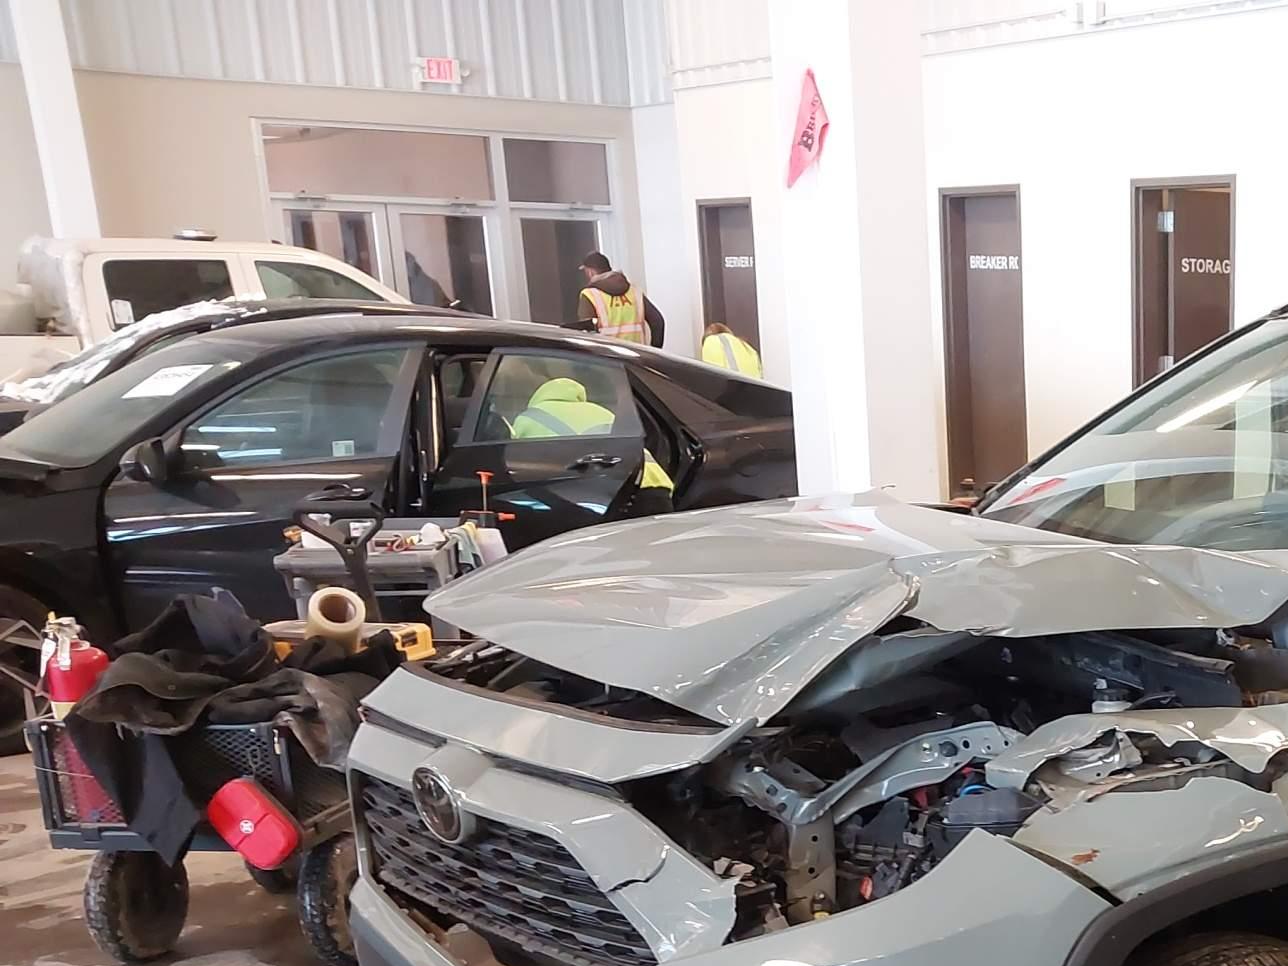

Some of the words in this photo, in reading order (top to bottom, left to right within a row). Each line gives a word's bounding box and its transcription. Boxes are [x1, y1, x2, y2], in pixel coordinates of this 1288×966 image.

[426, 59, 452, 80] EXIT
[970, 255, 1008, 269] BREAKER
[1181, 258, 1231, 274] STORAG
